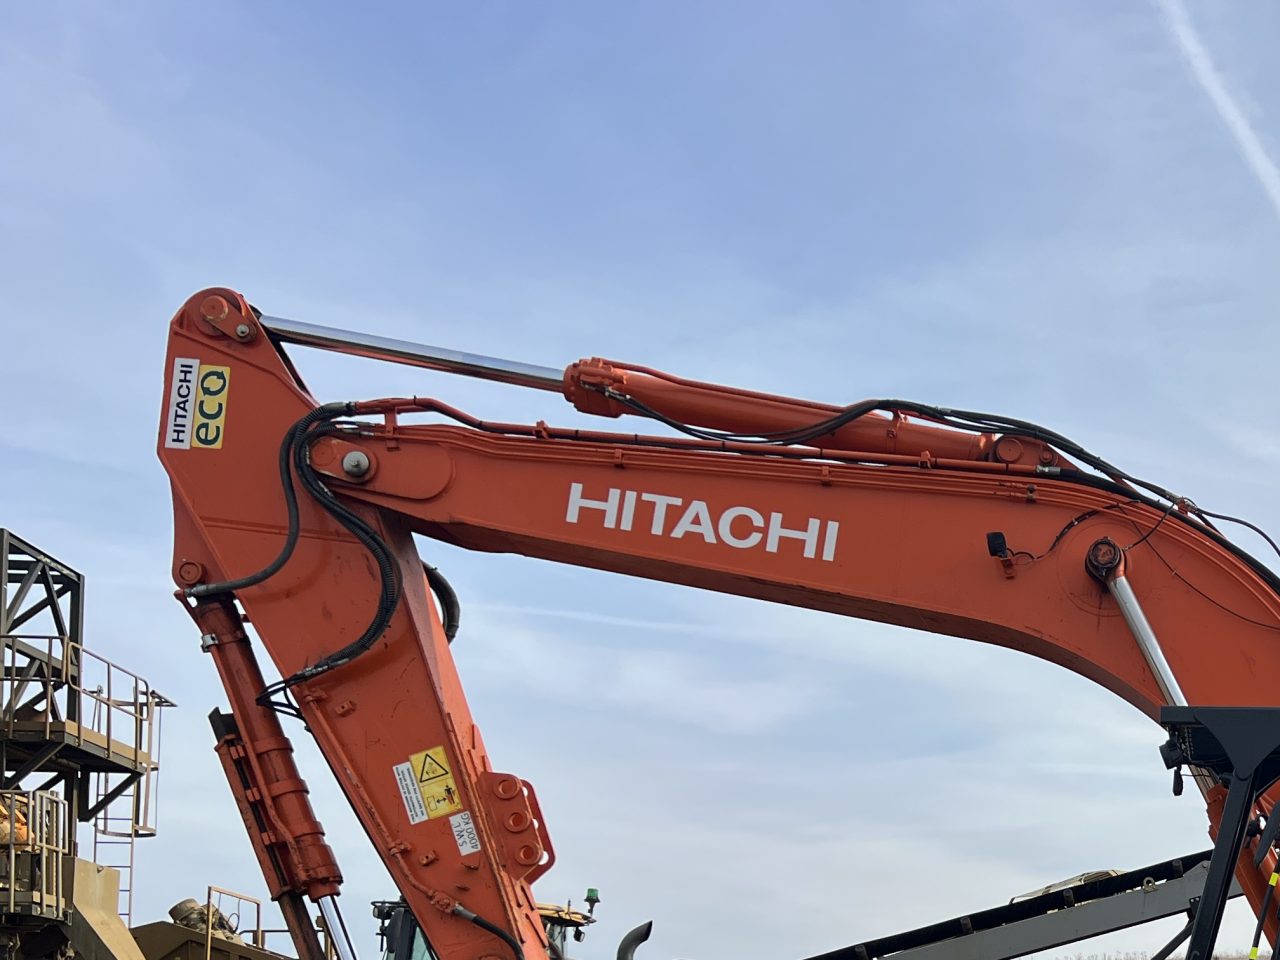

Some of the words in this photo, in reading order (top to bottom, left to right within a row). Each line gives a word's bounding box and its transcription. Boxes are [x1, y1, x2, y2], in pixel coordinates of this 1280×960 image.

[172, 364, 193, 443] HITACHI
[566, 482, 840, 562] HITACHI
[460, 813, 472, 826] KG
[465, 827, 479, 849] 4000
